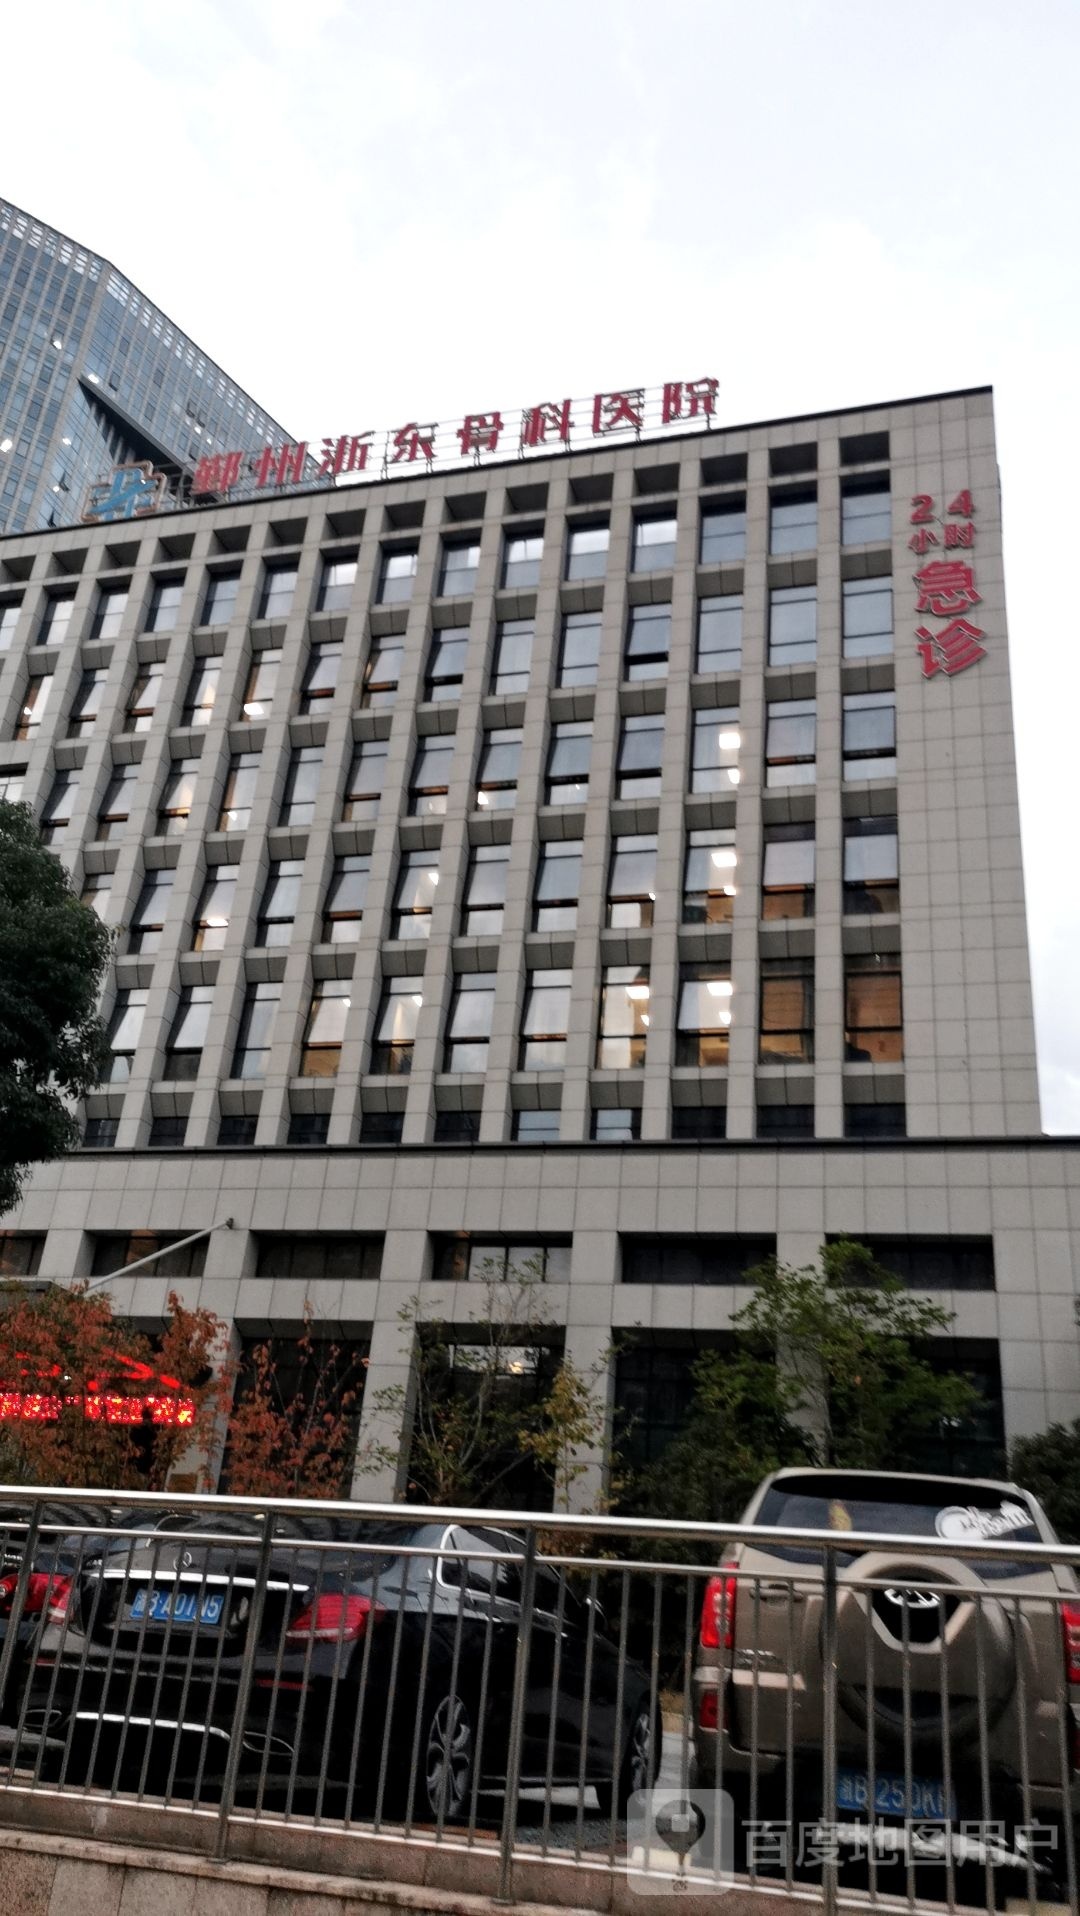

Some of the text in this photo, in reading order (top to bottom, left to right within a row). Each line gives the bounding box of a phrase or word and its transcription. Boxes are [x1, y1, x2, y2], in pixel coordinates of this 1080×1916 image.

[192, 377, 719, 494] 鄞州浙东骨科医院
[908, 522, 975, 554] 小时
[910, 489, 974, 524] 24
[913, 561, 986, 678] 急诊
